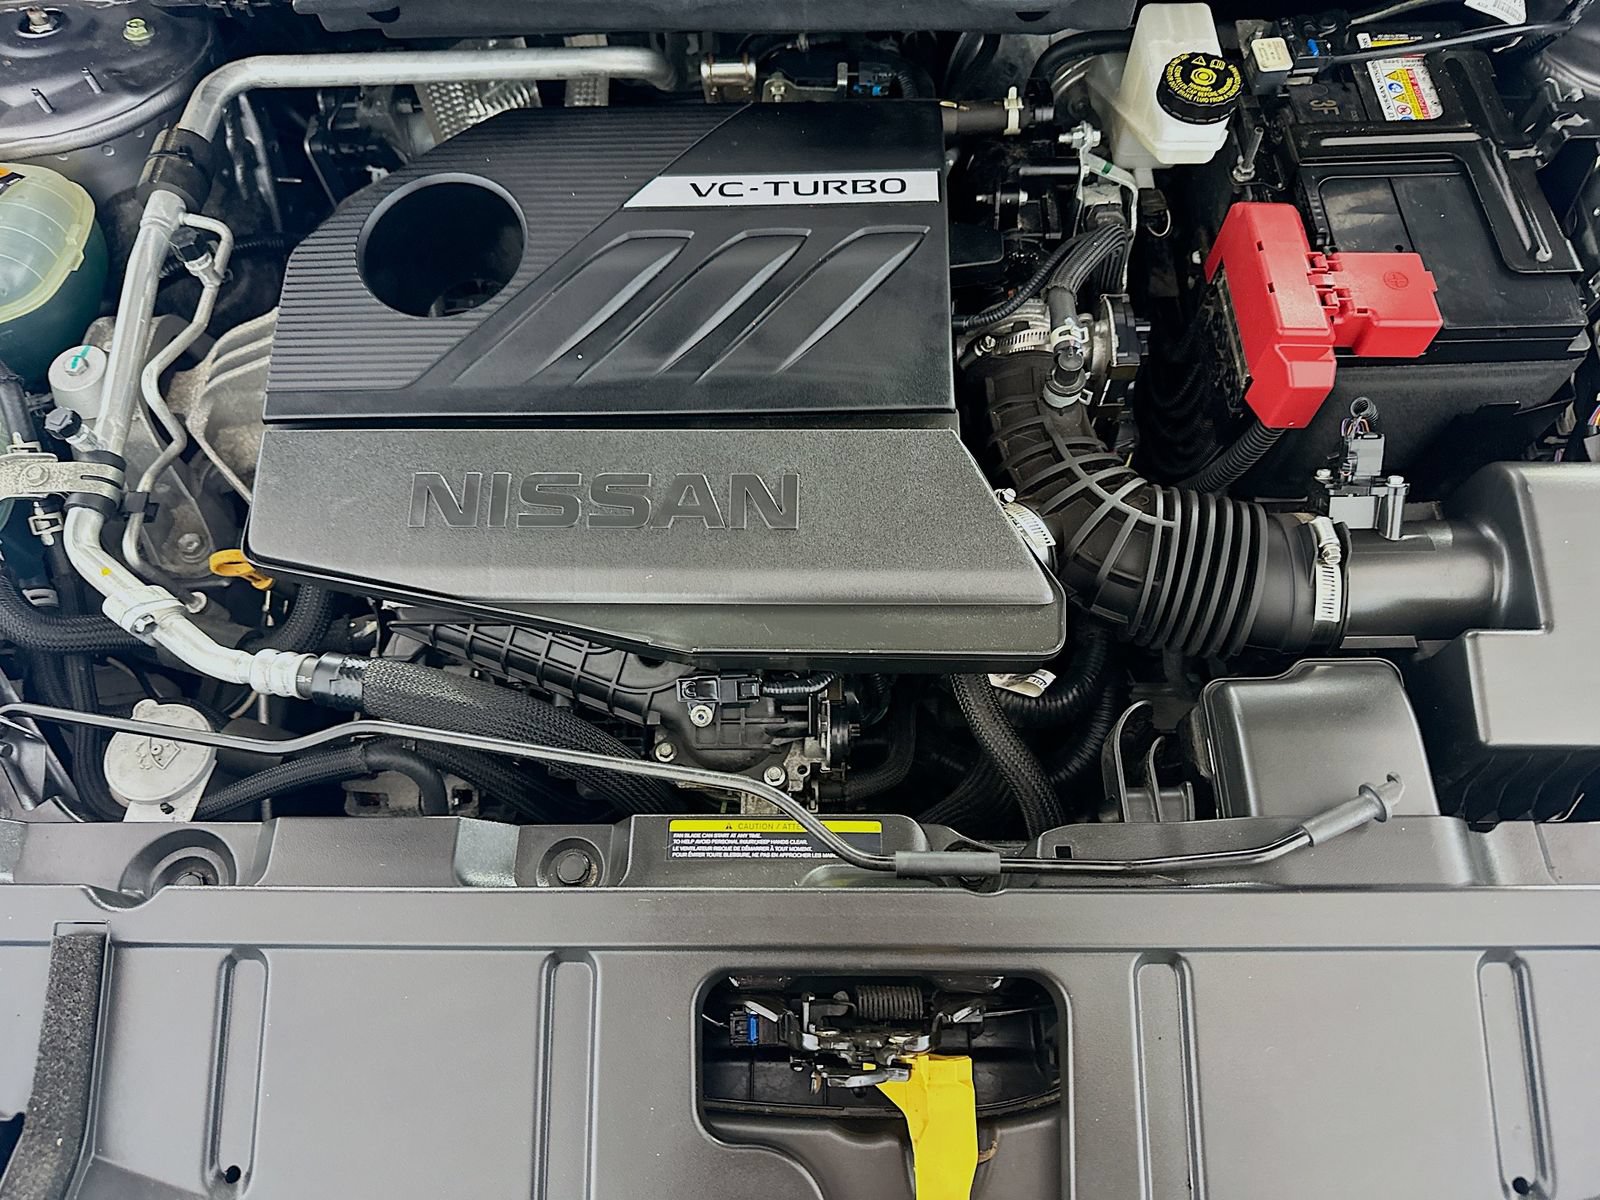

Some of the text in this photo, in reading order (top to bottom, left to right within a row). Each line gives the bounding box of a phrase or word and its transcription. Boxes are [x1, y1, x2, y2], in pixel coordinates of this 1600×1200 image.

[689, 178, 908, 198] VC-TURBO
[406, 471, 801, 529] NISSAN
[738, 822, 774, 830] CAUTION
